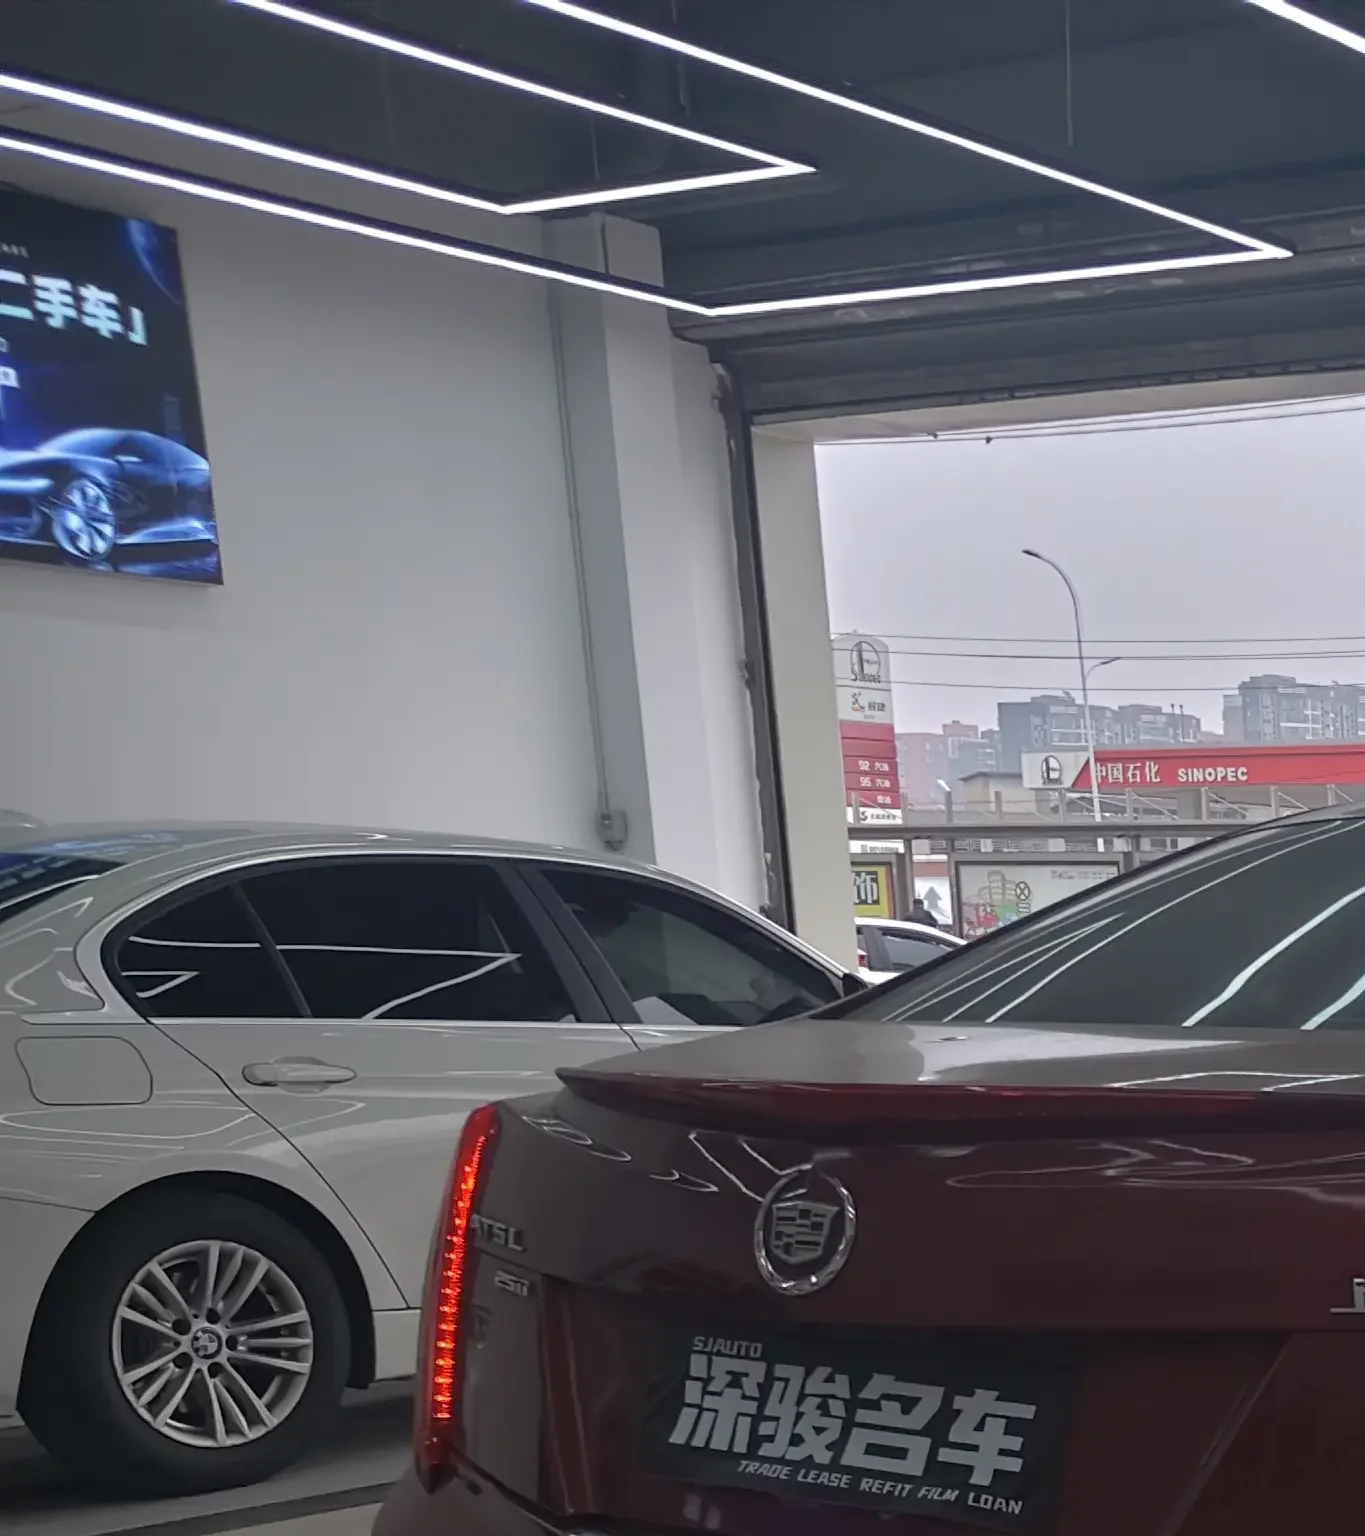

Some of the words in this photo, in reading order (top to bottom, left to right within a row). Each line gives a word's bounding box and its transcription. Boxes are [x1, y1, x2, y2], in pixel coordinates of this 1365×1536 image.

[1096, 761, 1160, 783] 中国石化
[1177, 767, 1249, 783] SINOPEC
[692, 1336, 763, 1358] SJAUTO
[668, 1353, 1037, 1487] 深骏名车
[736, 1460, 792, 1481] TRADE
[797, 1469, 851, 1489] LEASE
[859, 1477, 913, 1498] REFIT
[917, 1485, 959, 1502] FILM
[967, 1491, 1025, 1515] LOAN
